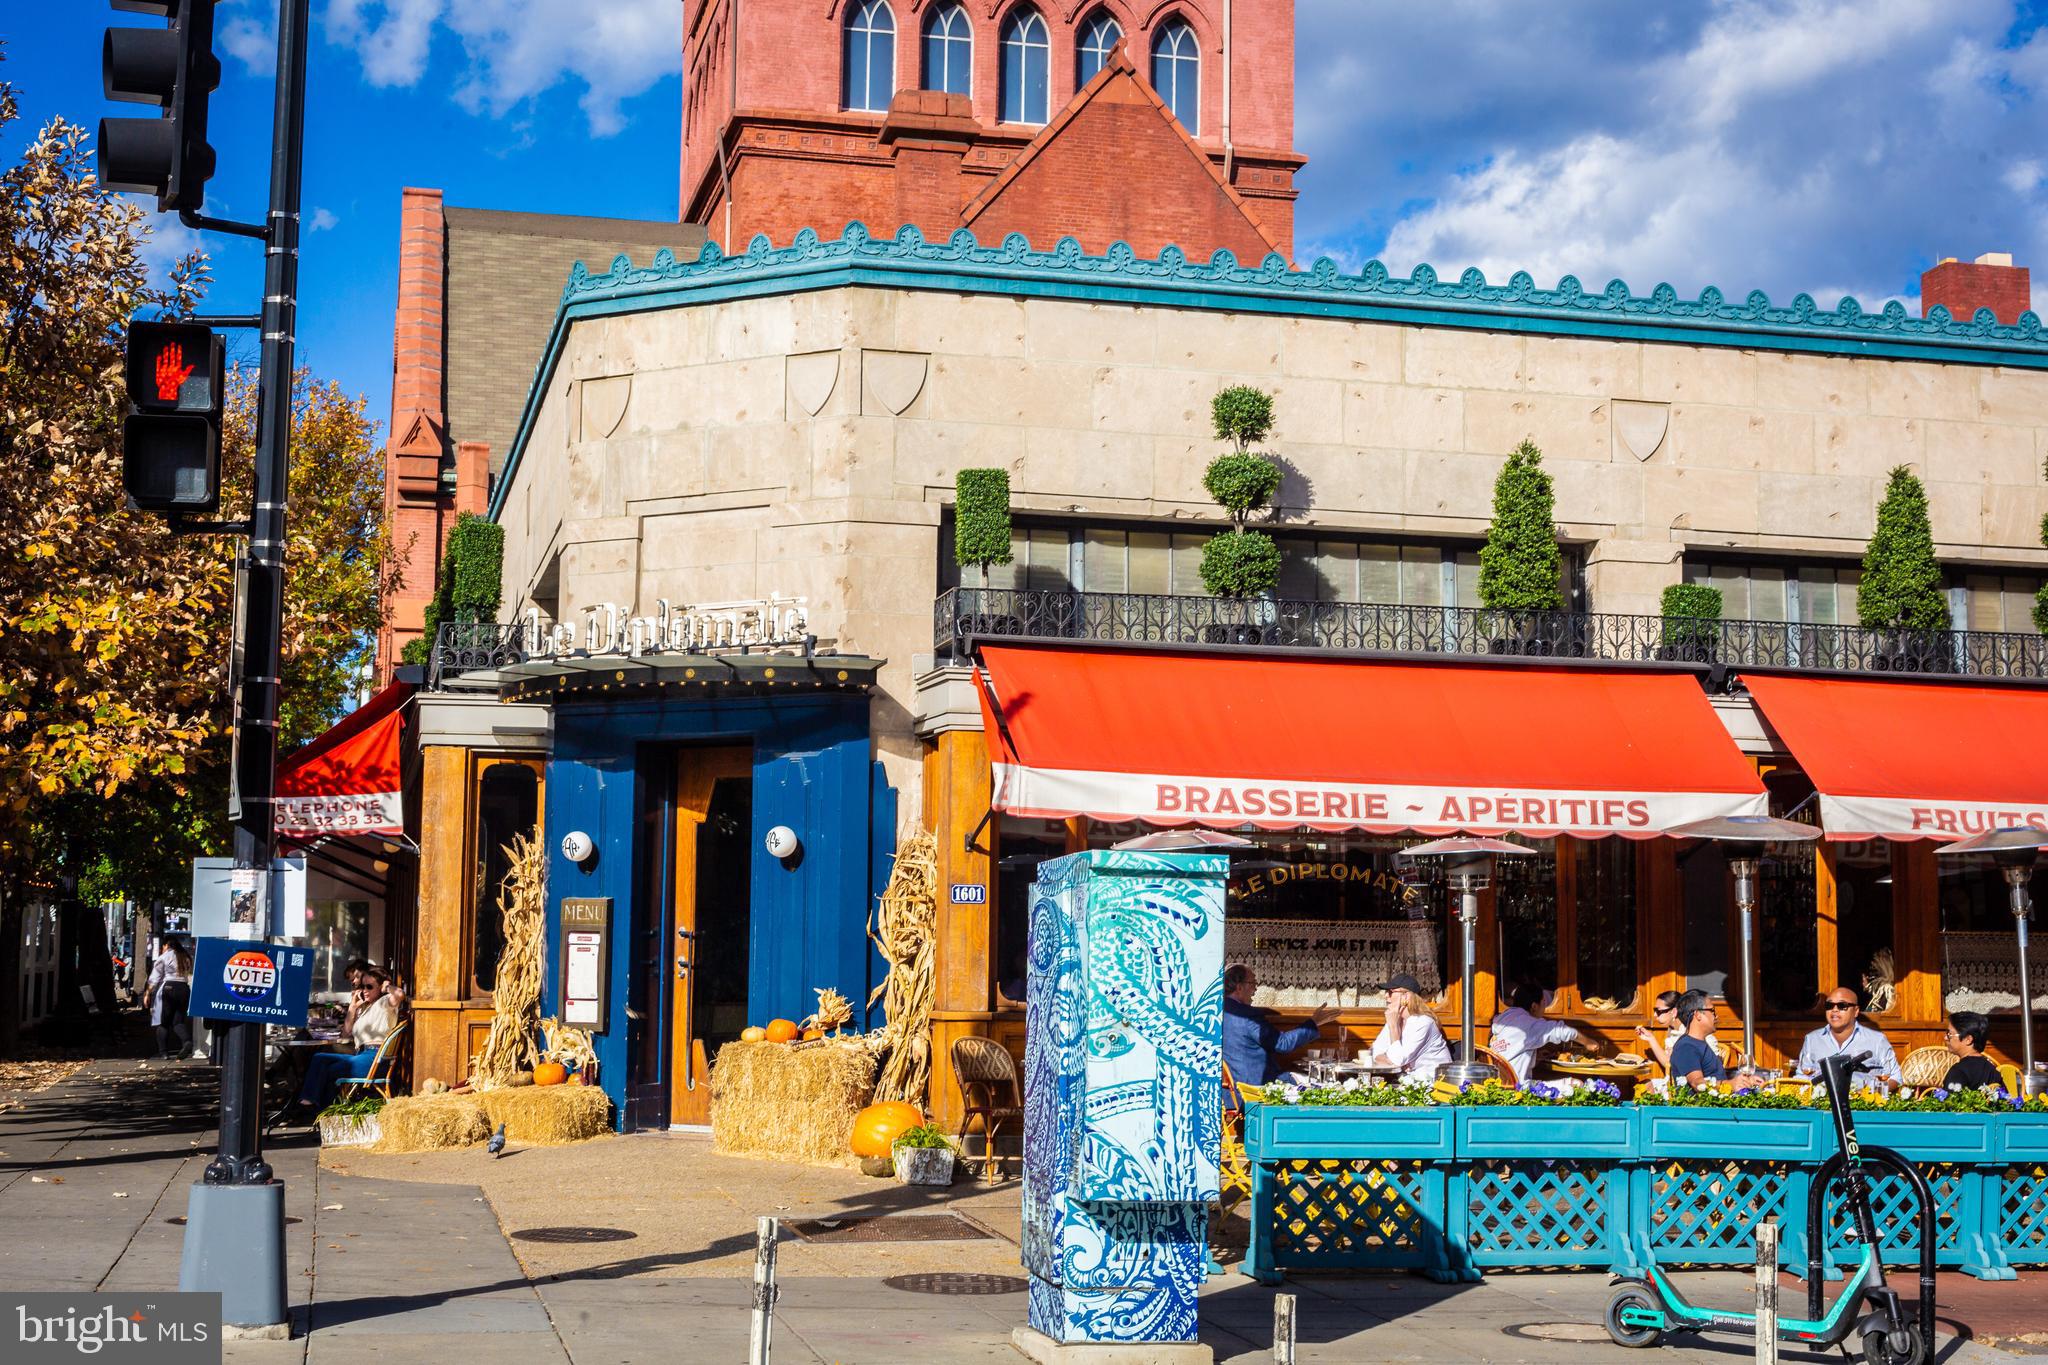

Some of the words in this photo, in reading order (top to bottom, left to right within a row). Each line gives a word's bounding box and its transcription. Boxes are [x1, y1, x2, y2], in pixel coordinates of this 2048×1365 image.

[527, 606, 577, 657] Le
[581, 591, 810, 657] Diplomate
[276, 800, 381, 814] ELEPHONE
[1156, 784, 1389, 819] BRASSERIE
[1438, 793, 1650, 827] APÉRITIFS
[290, 815, 309, 826] 23
[314, 816, 333, 827] 32
[338, 815, 358, 826] 33
[363, 813, 383, 824] 33
[1233, 874, 1265, 901] LE
[1269, 863, 1419, 907] DIPLOMATE
[954, 886, 983, 901] 1601
[564, 904, 604, 921] MENU
[1311, 938, 1348, 952] JOUR
[1349, 938, 1367, 951] ET
[228, 967, 272, 985] VOTE
[210, 1001, 236, 1011] WITH
[238, 1004, 263, 1014] YOUR
[265, 1007, 289, 1016] FORK
